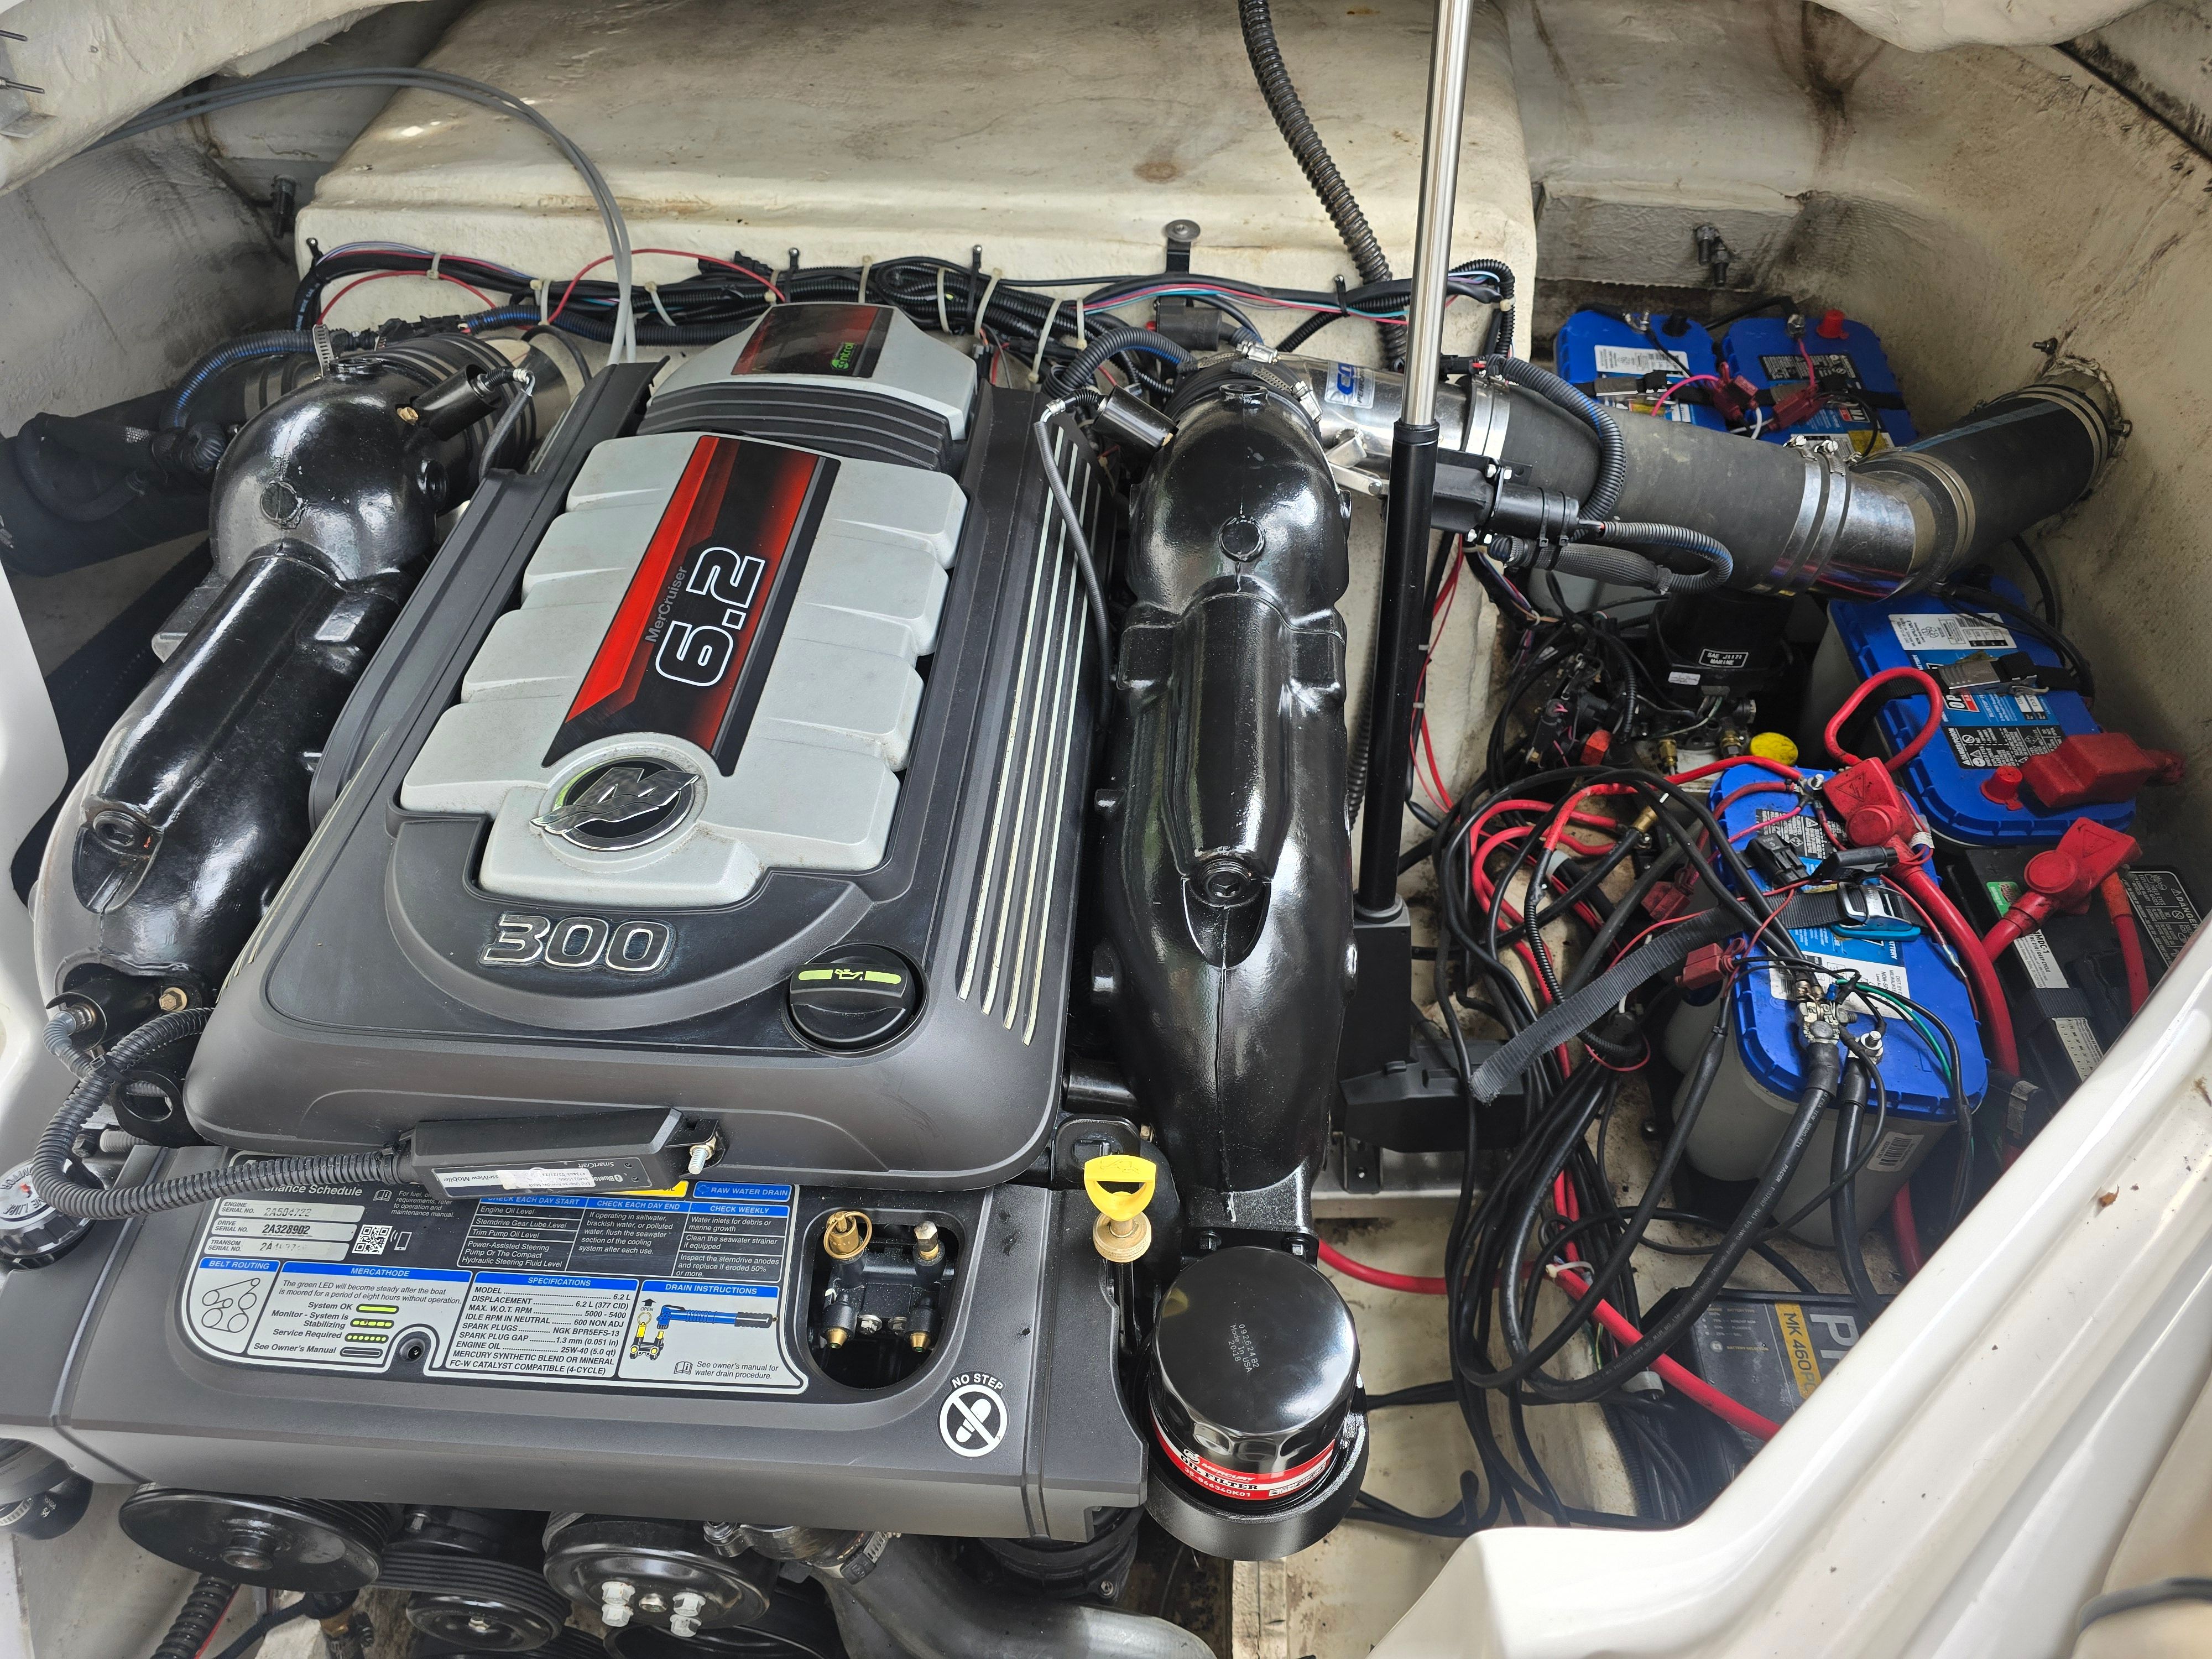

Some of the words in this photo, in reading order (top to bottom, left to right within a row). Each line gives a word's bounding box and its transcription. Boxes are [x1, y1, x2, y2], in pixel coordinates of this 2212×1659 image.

[645, 566, 687, 643] MerCruiser
[656, 546, 765, 686] 6.2
[2176, 896, 2198, 928] DANGER
[480, 912, 672, 973] 300
[1775, 1164, 1789, 1183] PACER
[308, 1185, 362, 1196] Schedule
[262, 1224, 311, 1235] 2A328902
[488, 1229, 508, 1238] Pump
[688, 1243, 721, 1251] equipped
[351, 1267, 410, 1276] MERCATHODE
[528, 1277, 591, 1286] SPECIFICATIONS
[375, 1285, 400, 1293] steady
[693, 1285, 757, 1294] INSTRUCTIONS
[307, 1301, 338, 1310] System
[472, 1295, 533, 1304] DISPLACEMENT
[612, 1302, 629, 1311] CID)
[309, 1311, 340, 1320] System
[304, 1321, 346, 1330] Stabilizing
[1783, 1312, 1803, 1336] MK
[305, 1330, 342, 1339] Required
[572, 1328, 619, 1337] BPR5EFS-13
[271, 1343, 305, 1352] Owner's
[589, 1348, 604, 1356] (5.0
[605, 1348, 616, 1357] qt)
[1228, 1340, 1241, 1361] 20:18
[1230, 1324, 1240, 1342] Made
[1238, 1346, 1245, 1354] In
[1243, 1357, 1253, 1373] USA
[452, 1350, 492, 1358] MERCURY
[492, 1352, 536, 1361] SYNTHETIC
[578, 1357, 614, 1365] MINERAL
[1251, 1358, 1260, 1368] B2
[472, 1360, 513, 1369] CATALYST
[514, 1363, 565, 1372] COMPATIBLE
[566, 1365, 606, 1375] (4-CYCLE)
[951, 1374, 970, 1389] NO
[973, 1373, 1003, 1391] STEP
[1181, 1455, 1202, 1474] OIL
[1204, 1472, 1259, 1490] FILTER
[1202, 1463, 1256, 1480] MERCURY
[1184, 1467, 1251, 1498] 35-866340K01
